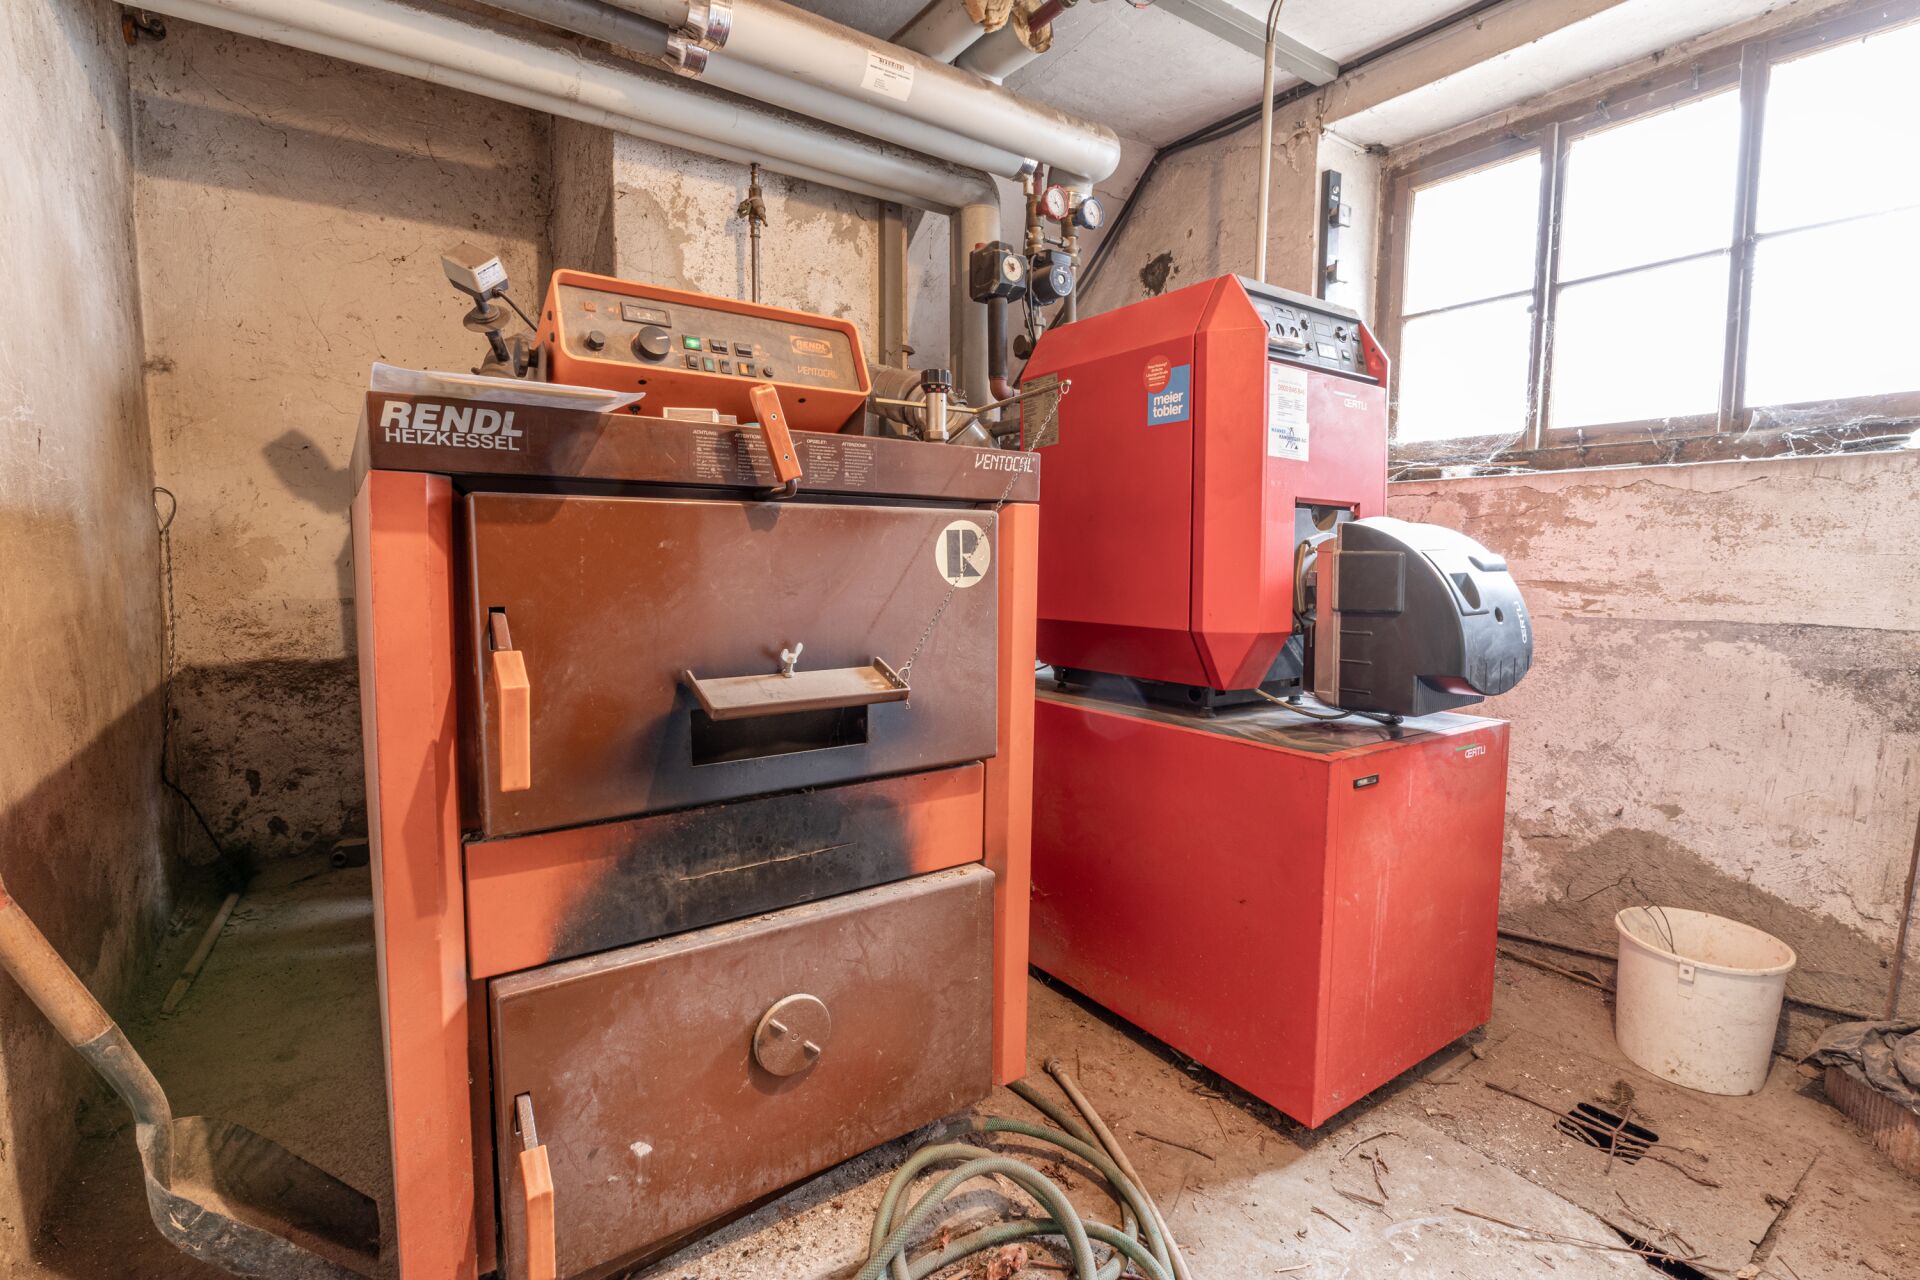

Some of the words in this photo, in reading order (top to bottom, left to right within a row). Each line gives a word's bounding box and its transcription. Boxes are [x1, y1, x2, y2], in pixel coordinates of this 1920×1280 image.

[1153, 391, 1183, 406] meier
[380, 400, 523, 437] RENDL
[1153, 404, 1183, 418] tobler
[385, 427, 520, 451] HEIZKESSEL
[974, 453, 1033, 473] VENTOCAL
